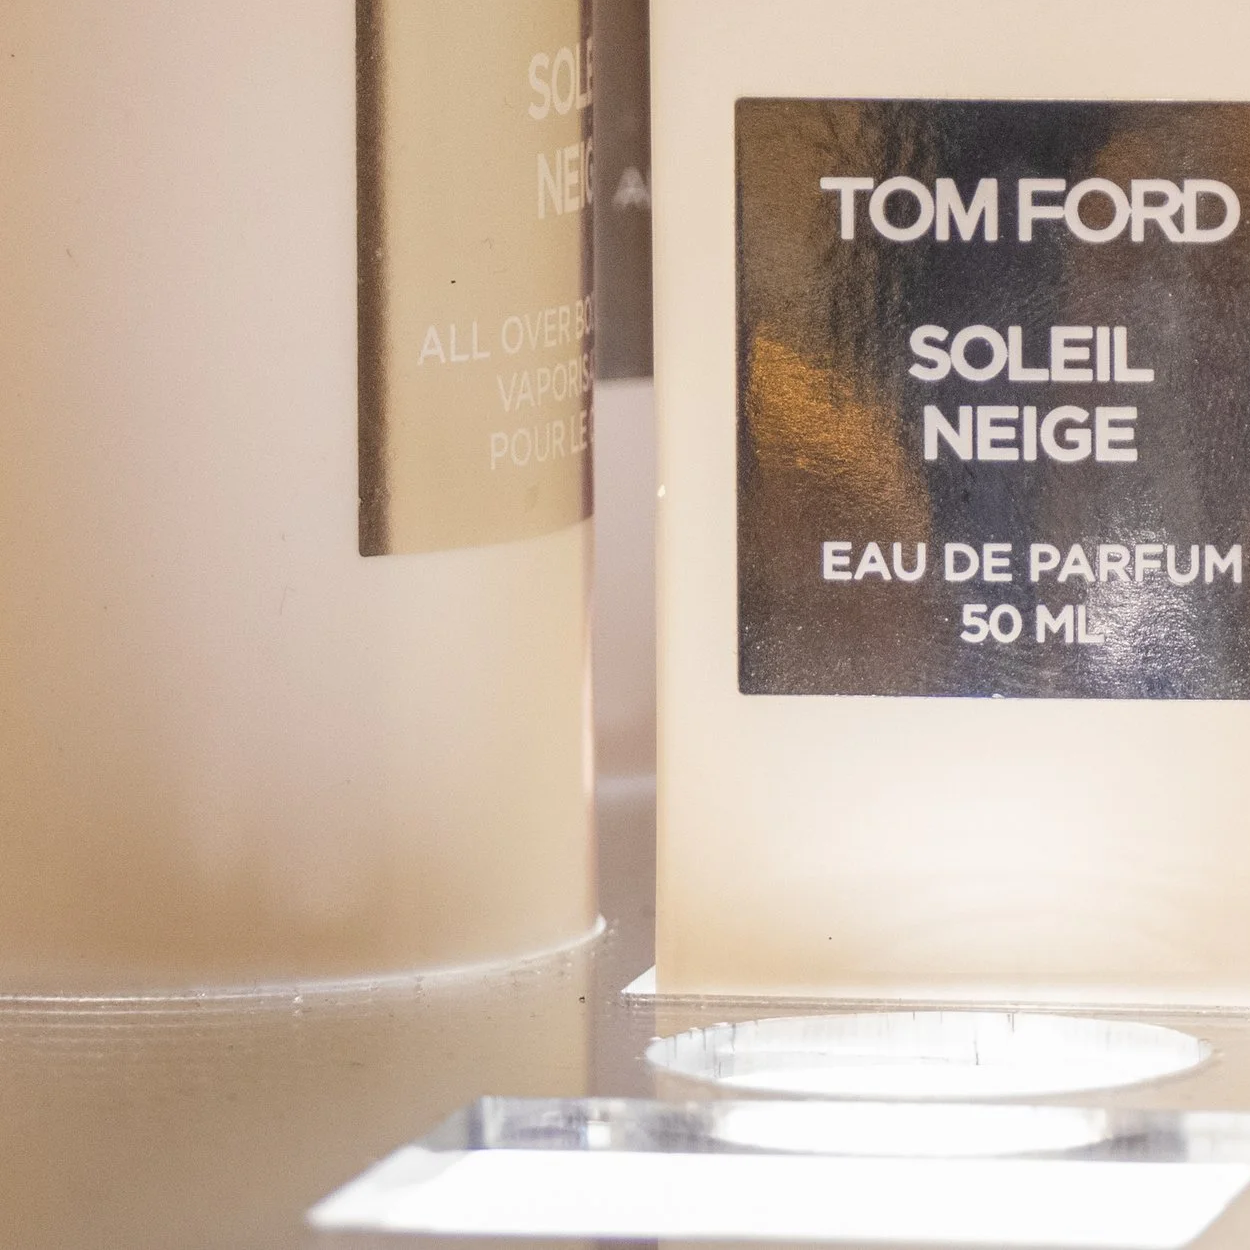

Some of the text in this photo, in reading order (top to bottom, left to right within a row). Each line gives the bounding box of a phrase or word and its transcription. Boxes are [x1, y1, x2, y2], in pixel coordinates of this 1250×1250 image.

[819, 176, 1242, 244] TOM FORD
[416, 319, 491, 367] ALL
[500, 306, 570, 355] OVER
[907, 323, 1155, 383] SOLEIL
[489, 419, 566, 471] POUR
[922, 405, 1139, 462] NEIGE
[821, 541, 1243, 584] EAU DE PARFUM
[959, 604, 1106, 644] 50 ML
